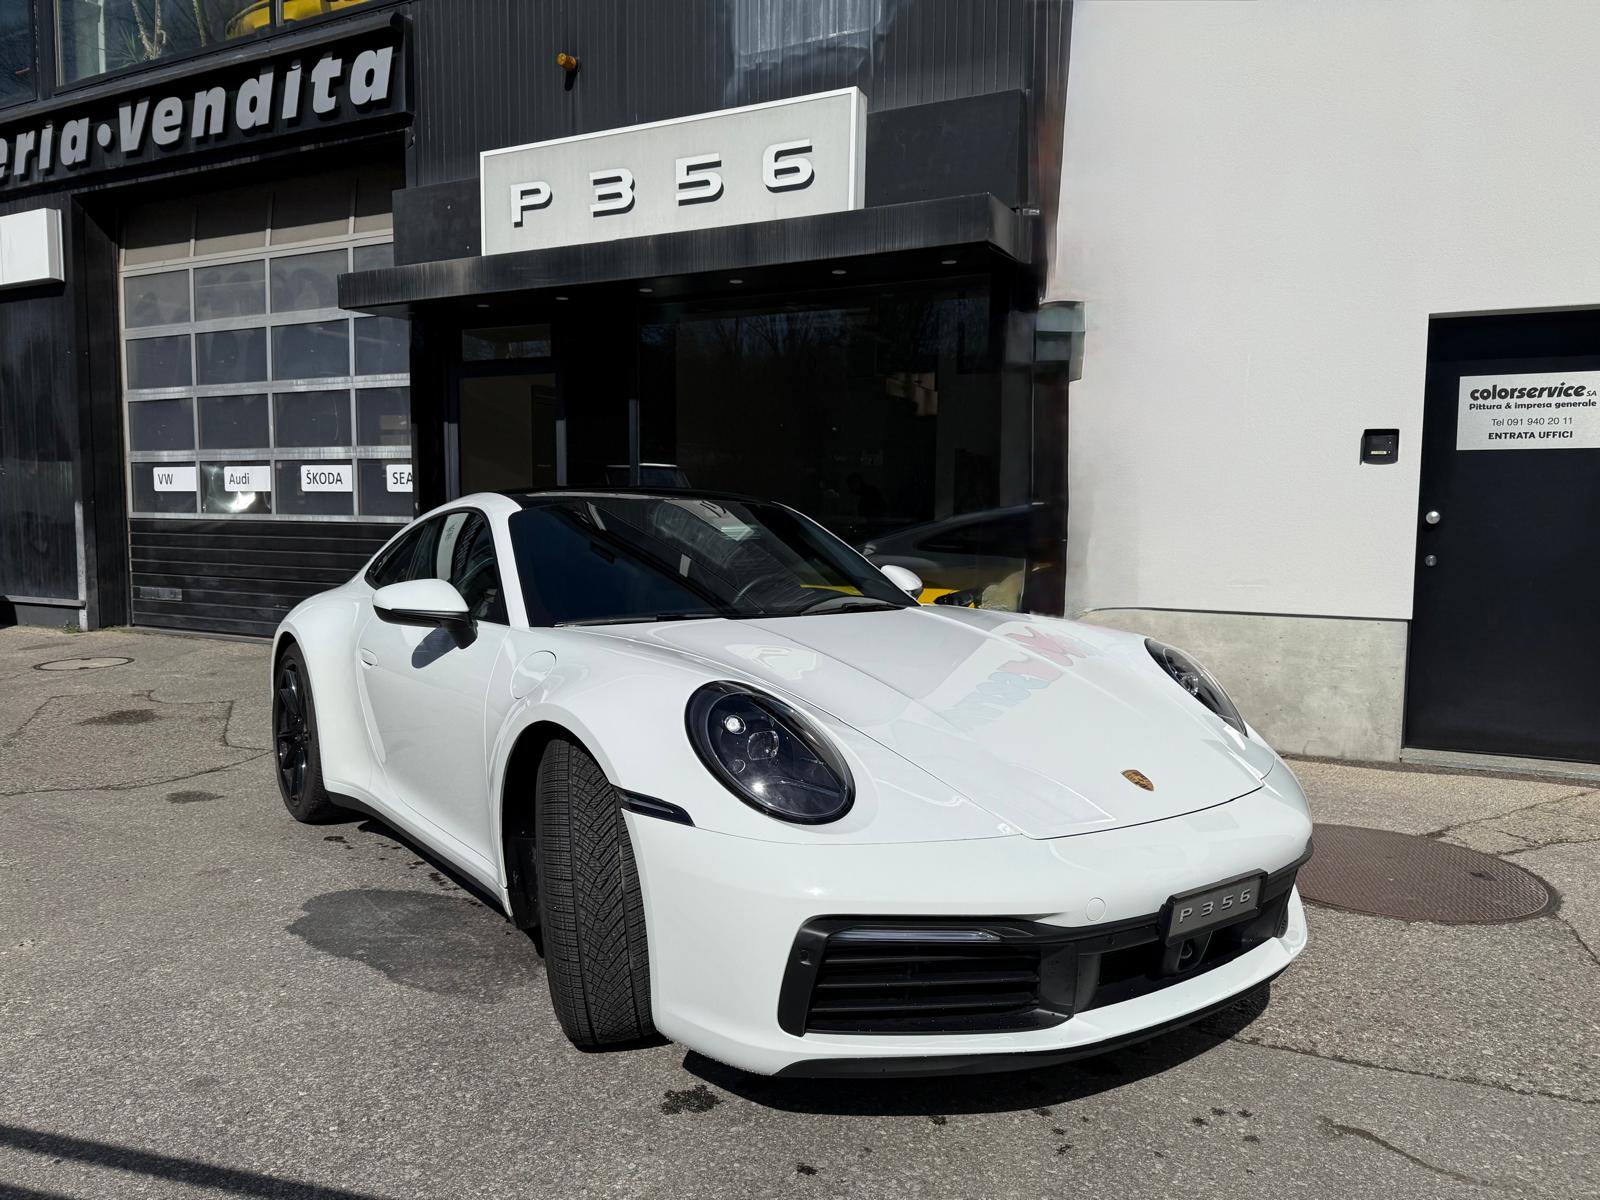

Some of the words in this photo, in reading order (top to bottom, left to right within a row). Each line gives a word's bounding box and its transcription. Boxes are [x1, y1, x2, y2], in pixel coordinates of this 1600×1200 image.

[1470, 382, 1587, 401] colorservice
[1469, 403, 1502, 411] Pittura
[1504, 402, 1513, 410] &
[1514, 402, 1552, 410] impresa
[1554, 399, 1597, 409] generale
[1491, 418, 1505, 426] Tel
[1507, 418, 1523, 426] 091
[1527, 417, 1545, 426] 940
[1547, 417, 1560, 425] 20
[1563, 417, 1573, 425] 11
[1488, 431, 1536, 440] ENTRATA
[1538, 430, 1573, 439] UFFICI
[157, 473, 174, 485] VW
[228, 473, 250, 485] Audi
[306, 469, 343, 485] ŠKODA
